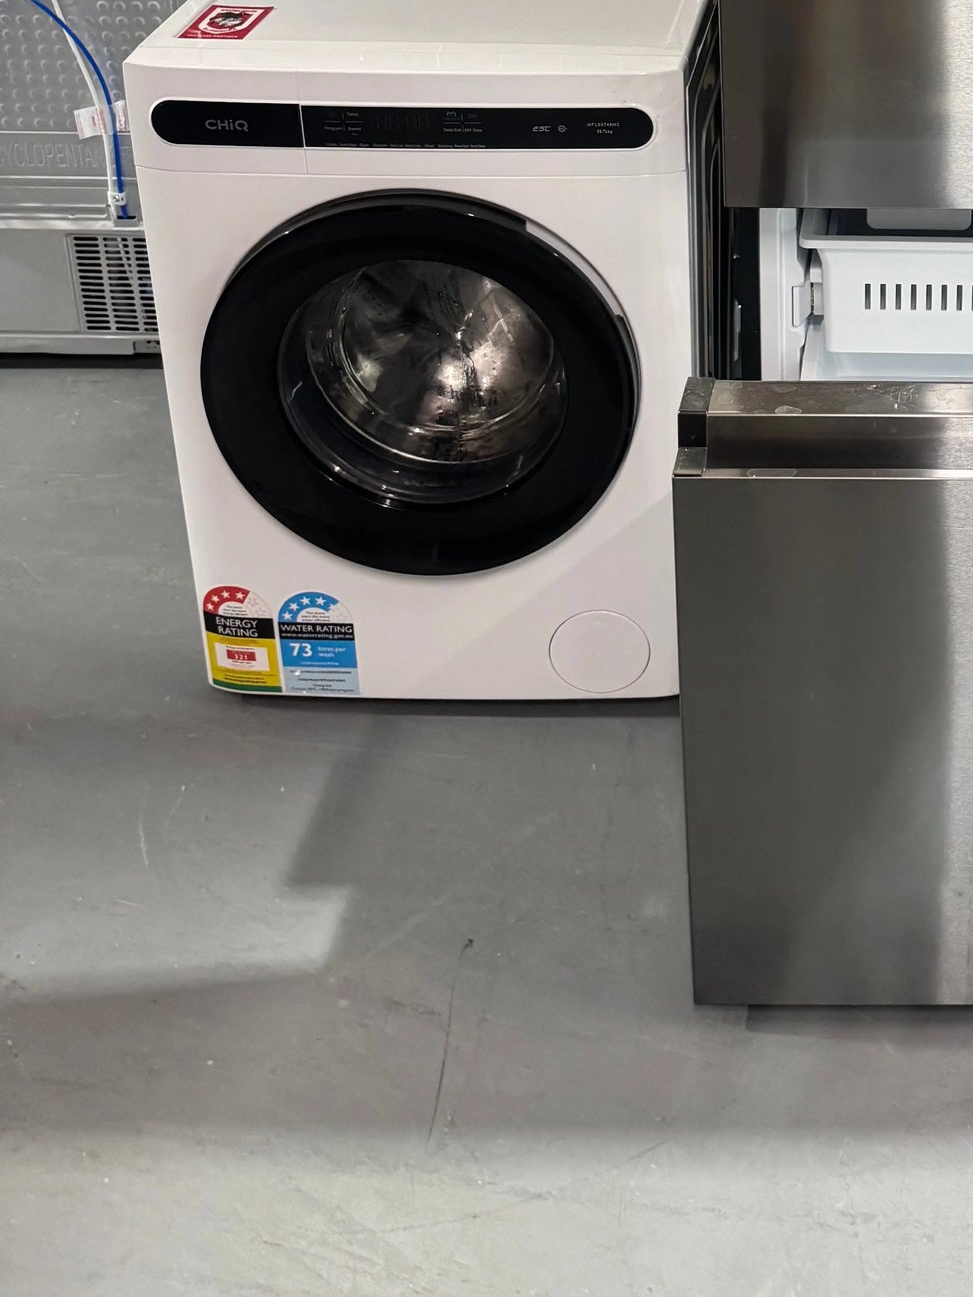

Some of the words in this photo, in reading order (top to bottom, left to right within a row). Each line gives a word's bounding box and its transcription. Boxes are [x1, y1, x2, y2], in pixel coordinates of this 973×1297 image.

[205, 119, 249, 132] CHiQ
[0, 140, 108, 170] YCLOPENTAN
[215, 616, 258, 629] ENERGY
[280, 624, 314, 632] WATER
[316, 625, 353, 633] RATING
[217, 626, 258, 637] RATING
[289, 642, 313, 657] 73
